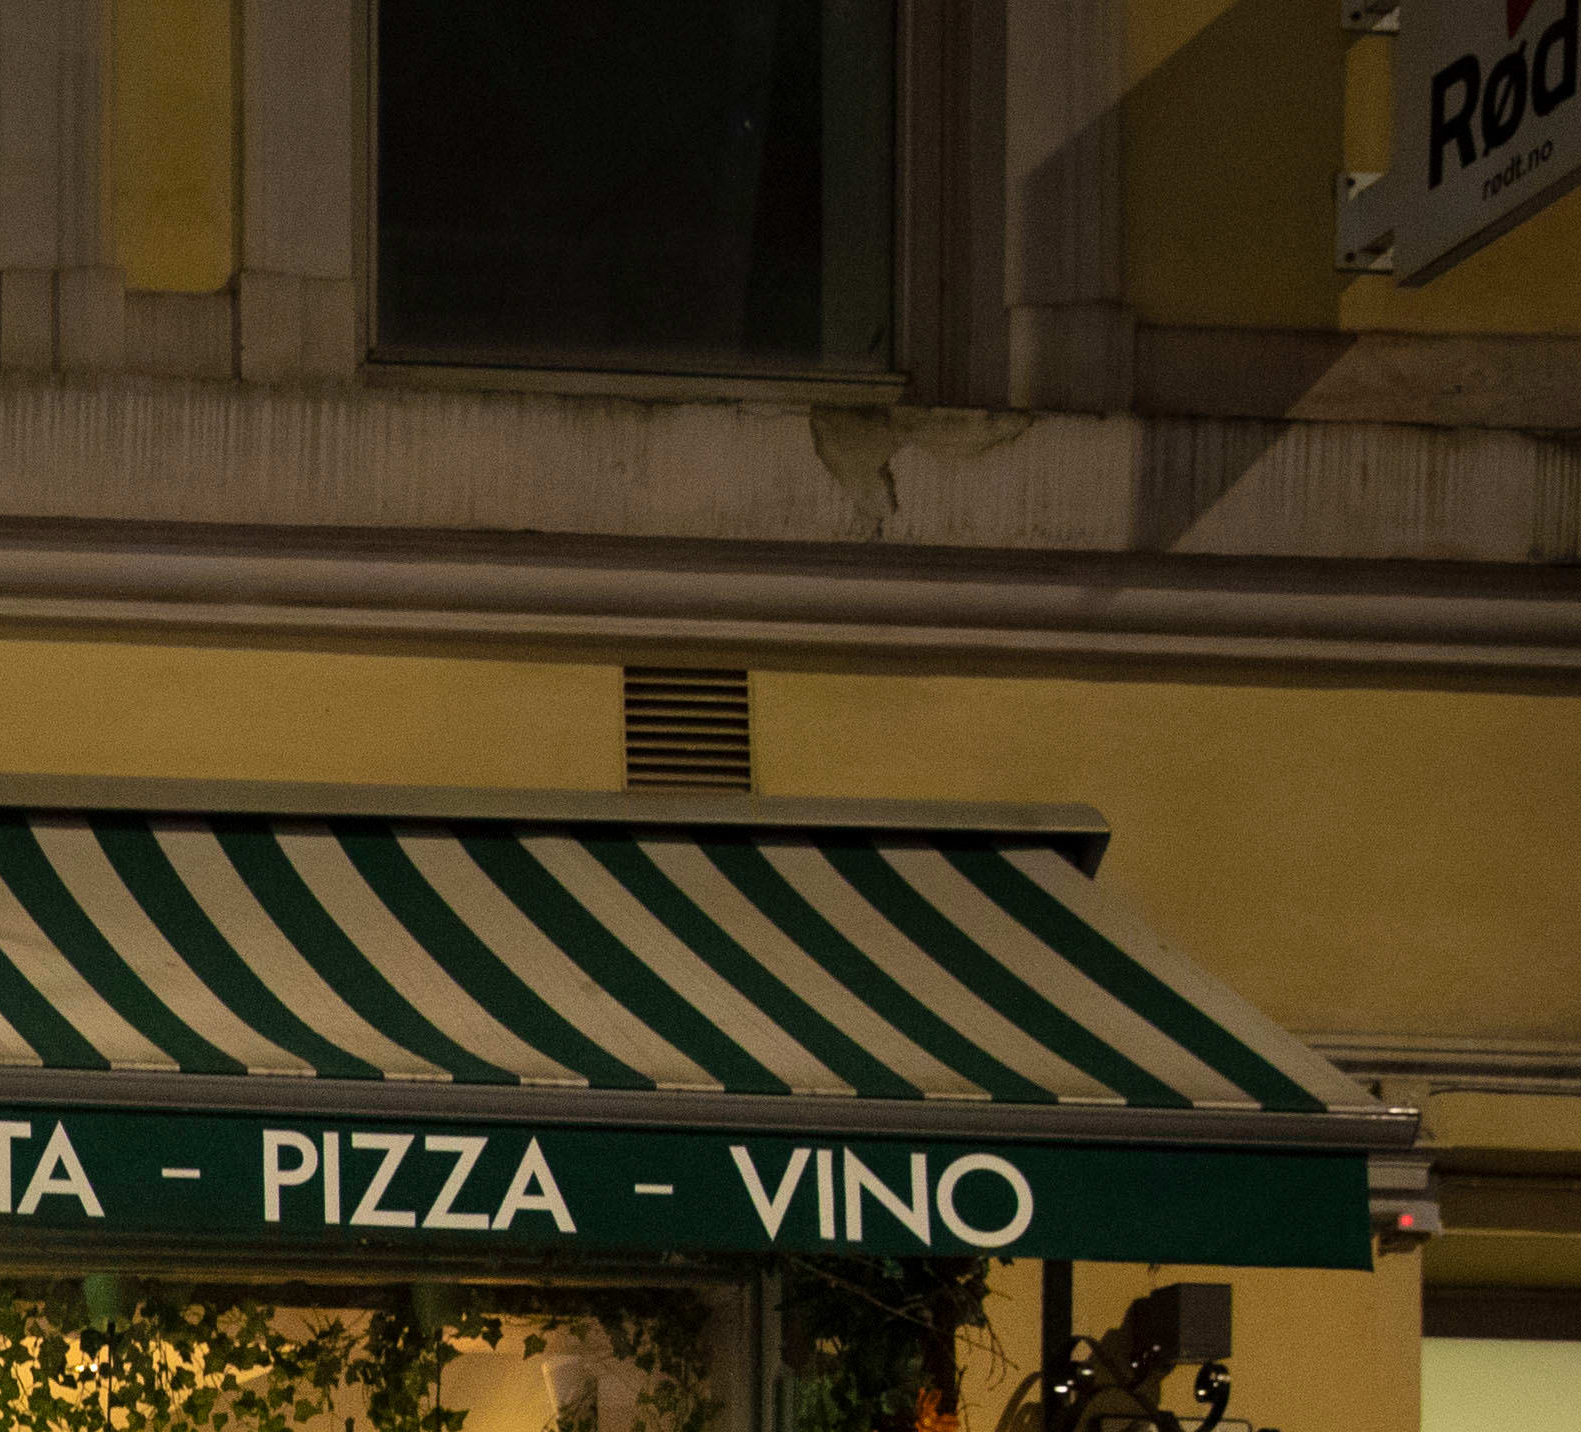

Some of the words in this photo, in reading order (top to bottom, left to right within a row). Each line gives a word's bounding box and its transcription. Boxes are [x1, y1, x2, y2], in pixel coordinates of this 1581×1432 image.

[1428, 0, 1579, 190] Rød
[1482, 140, 1554, 202] rødt.no
[262, 1128, 579, 1234] PIZZA
[727, 1144, 1035, 1250] VINO
